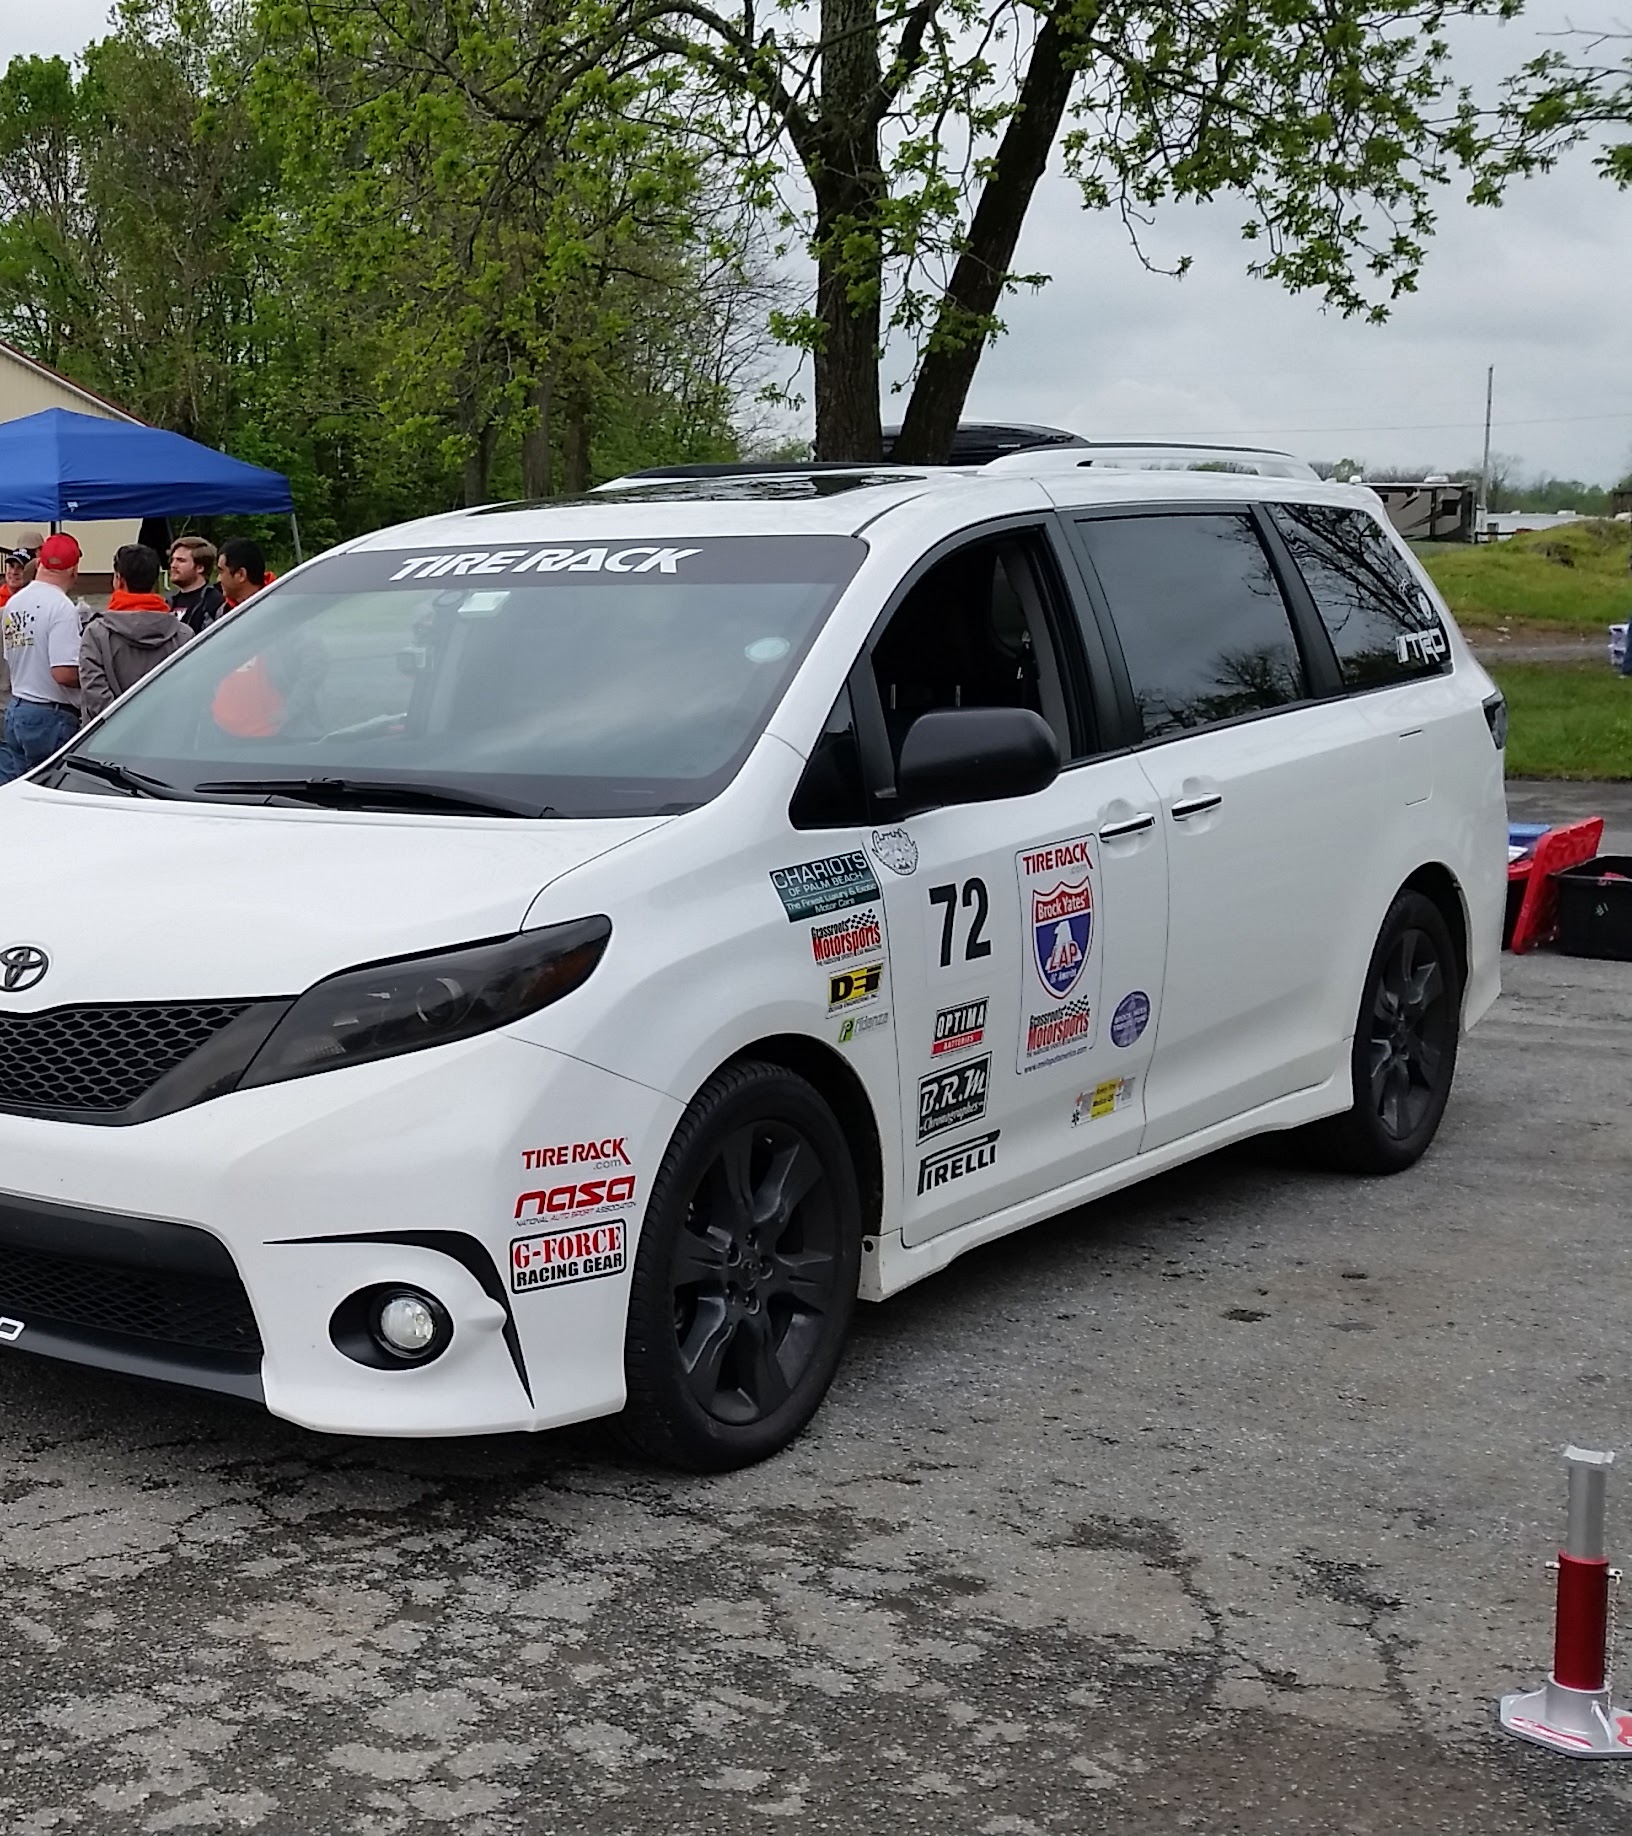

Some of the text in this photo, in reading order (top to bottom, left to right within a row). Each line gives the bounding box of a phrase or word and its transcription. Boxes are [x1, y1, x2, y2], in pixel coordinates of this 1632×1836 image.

[389, 547, 703, 581] TIRE RACK
[1406, 628, 1446, 664] TRD
[772, 852, 867, 889] CHARIOTS
[1023, 842, 1093, 875] TIRE RACK
[788, 871, 864, 897] OF PALM BEACH
[785, 902, 801, 910] The
[801, 897, 824, 907] Finest
[1038, 901, 1061, 920] Brock
[810, 920, 849, 938] Grassroots
[928, 877, 992, 967] 72
[812, 922, 882, 961] Motorsports
[1049, 943, 1078, 971] LAP
[936, 1004, 985, 1038] OPTIMA
[1027, 1013, 1089, 1051] Motorsports
[1030, 1008, 1064, 1027] Grassroots
[943, 1035, 974, 1050] BATTERIES
[522, 1137, 631, 1170] TIRE RACK
[593, 1159, 621, 1171] .com
[917, 1129, 1001, 1196] PIRELLI
[514, 1175, 636, 1219] nasa
[550, 1212, 570, 1221] AUTO
[571, 1208, 595, 1218] SPORT
[596, 1201, 637, 1213] ASSOCIATION
[514, 1227, 621, 1269] G-FORCE
[517, 1253, 622, 1287] RACING GEAR
